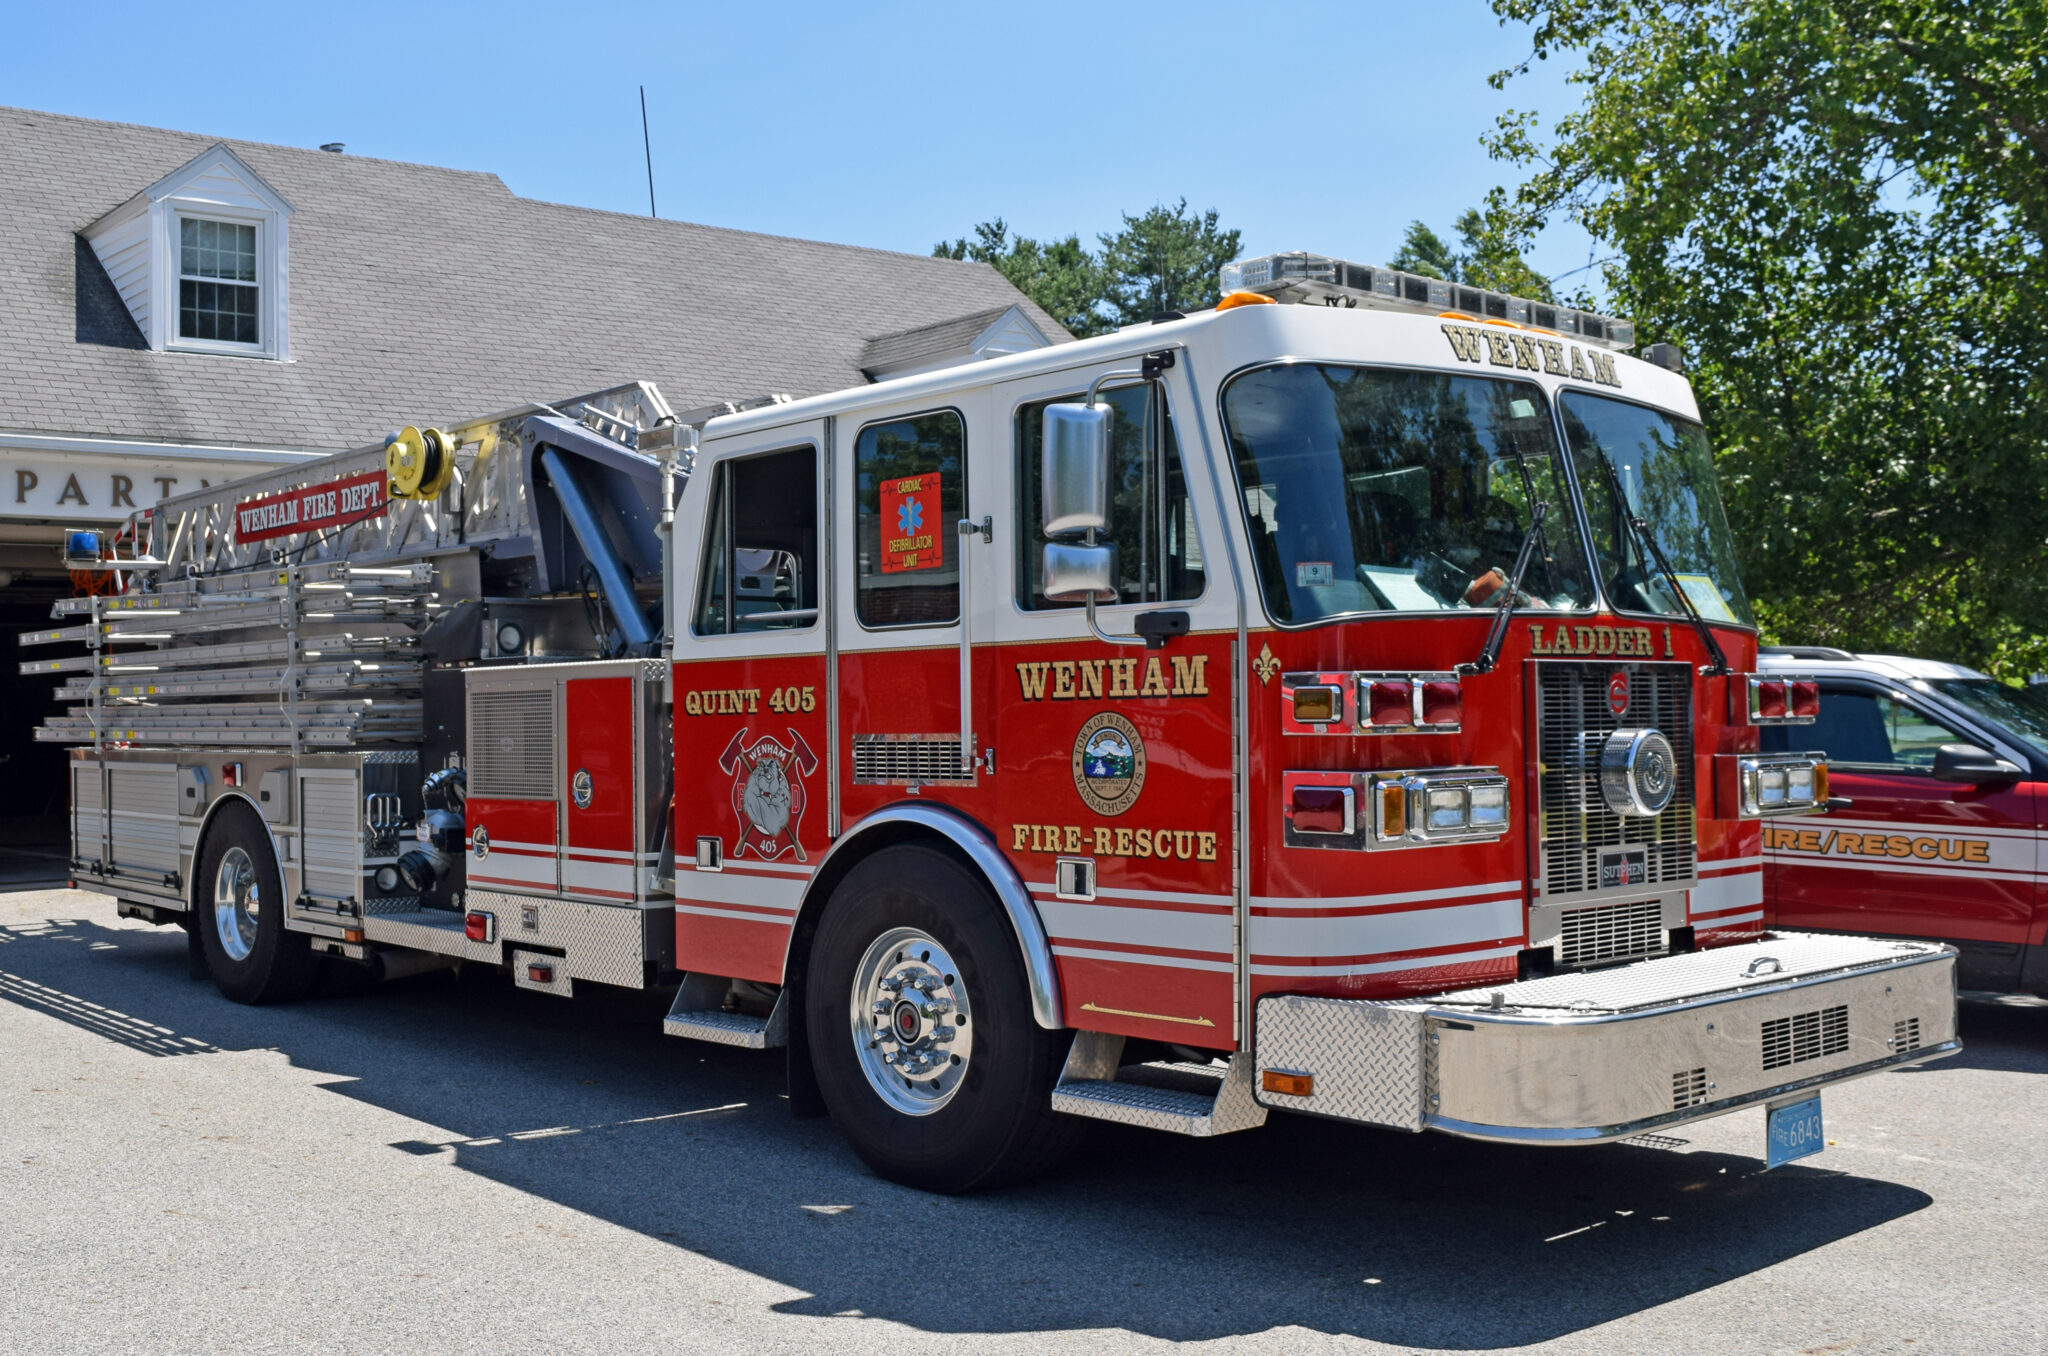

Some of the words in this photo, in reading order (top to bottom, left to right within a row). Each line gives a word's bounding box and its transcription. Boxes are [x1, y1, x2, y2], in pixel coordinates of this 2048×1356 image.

[1441, 324, 1622, 388] WENHAM
[15, 469, 231, 508] PART
[897, 478, 922, 494] CARDIAC
[240, 499, 298, 534] WENHAM
[302, 490, 336, 522] FIRE
[341, 481, 383, 514] DEPT.
[889, 535, 933, 553] DEFIBRILLATOR
[903, 553, 918, 568] UNIT
[1311, 567, 1319, 576] 9
[1530, 625, 1654, 657] LADDER
[1663, 626, 1675, 658] 1
[1016, 655, 1209, 700] WENHAM
[685, 688, 761, 716] QUINT
[768, 686, 817, 714] 405
[1075, 723, 1093, 755] TOWN
[1093, 715, 1105, 727] OF
[1107, 714, 1142, 754] WENHAM
[749, 743, 787, 761] WENHAM
[1076, 772, 1143, 813] MASSACHUSETTS
[760, 839, 777, 853] 405
[1012, 824, 1217, 862] FIRE-RESCUE
[1761, 827, 1990, 863] IRE/RESCUE
[1603, 862, 1644, 879] SUTPHEN
[1772, 1123, 1790, 1147] FIRE
[1790, 1115, 1820, 1147] 6843
